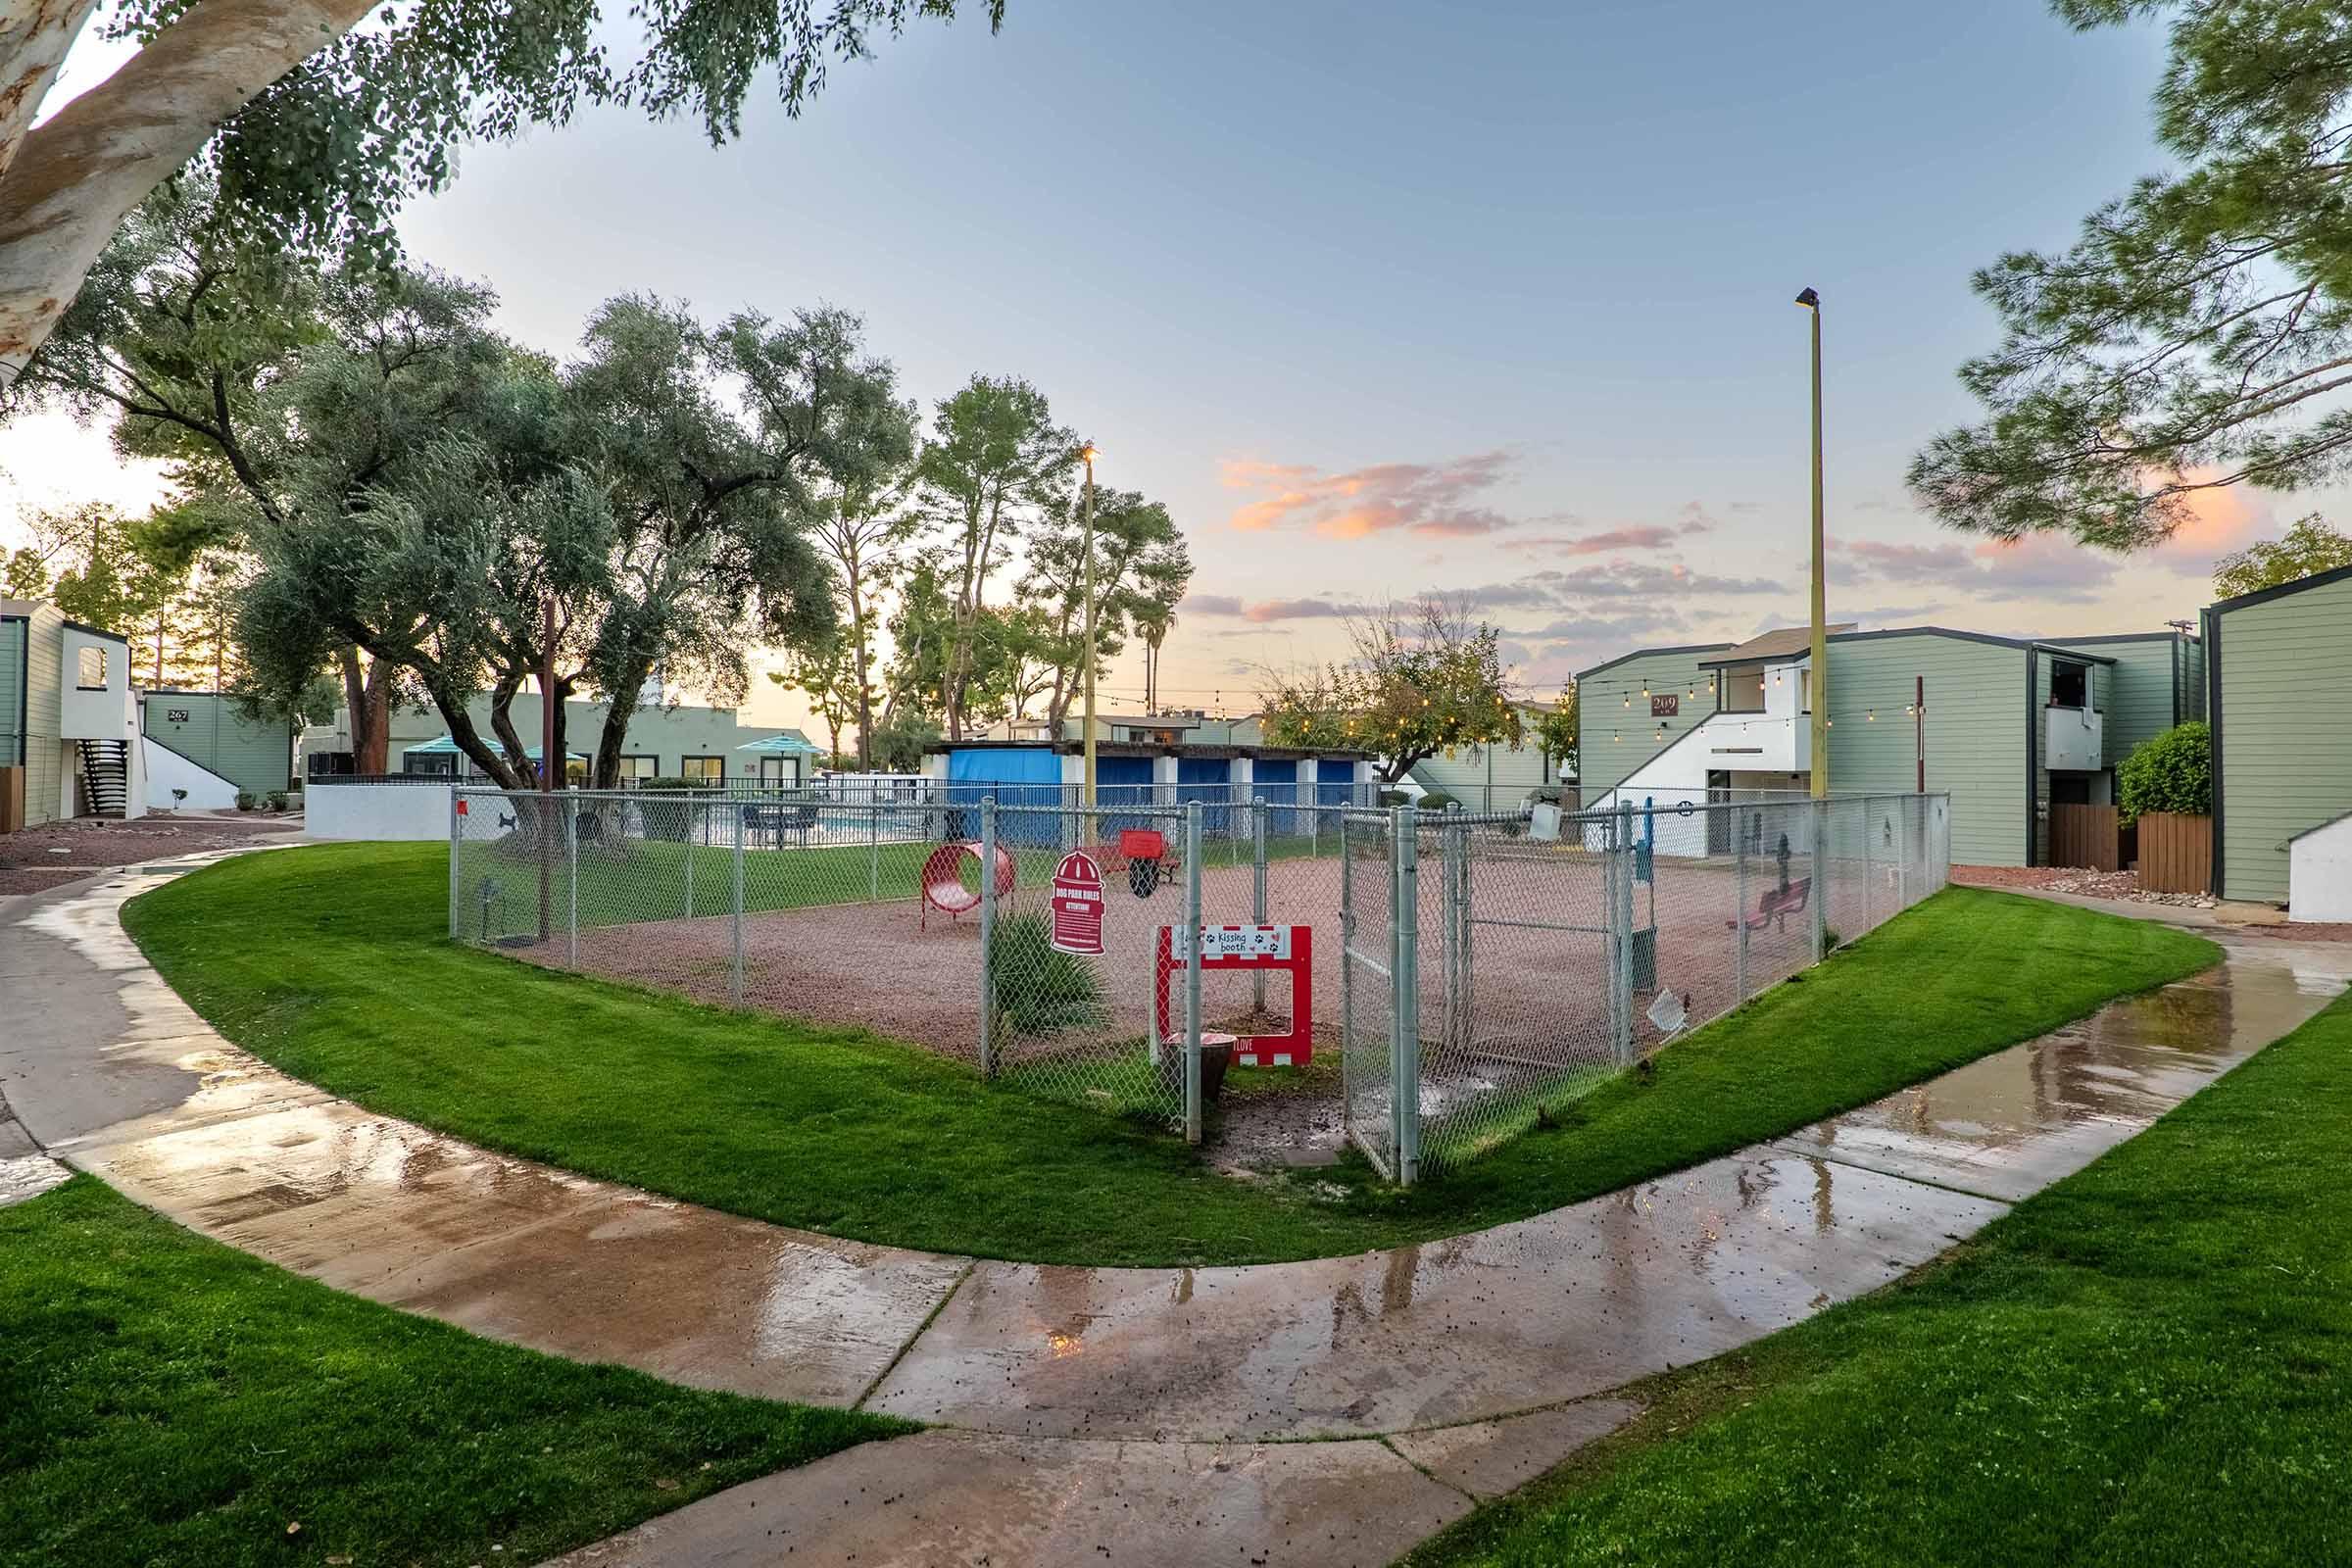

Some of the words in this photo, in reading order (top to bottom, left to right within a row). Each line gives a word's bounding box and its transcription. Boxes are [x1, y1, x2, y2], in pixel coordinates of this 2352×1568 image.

[1653, 697, 1676, 710] 209
[1056, 888, 1067, 898] DOG
[1068, 889, 1083, 900] PARK
[1083, 890, 1100, 902] RULES
[1221, 942, 1246, 953] booth
